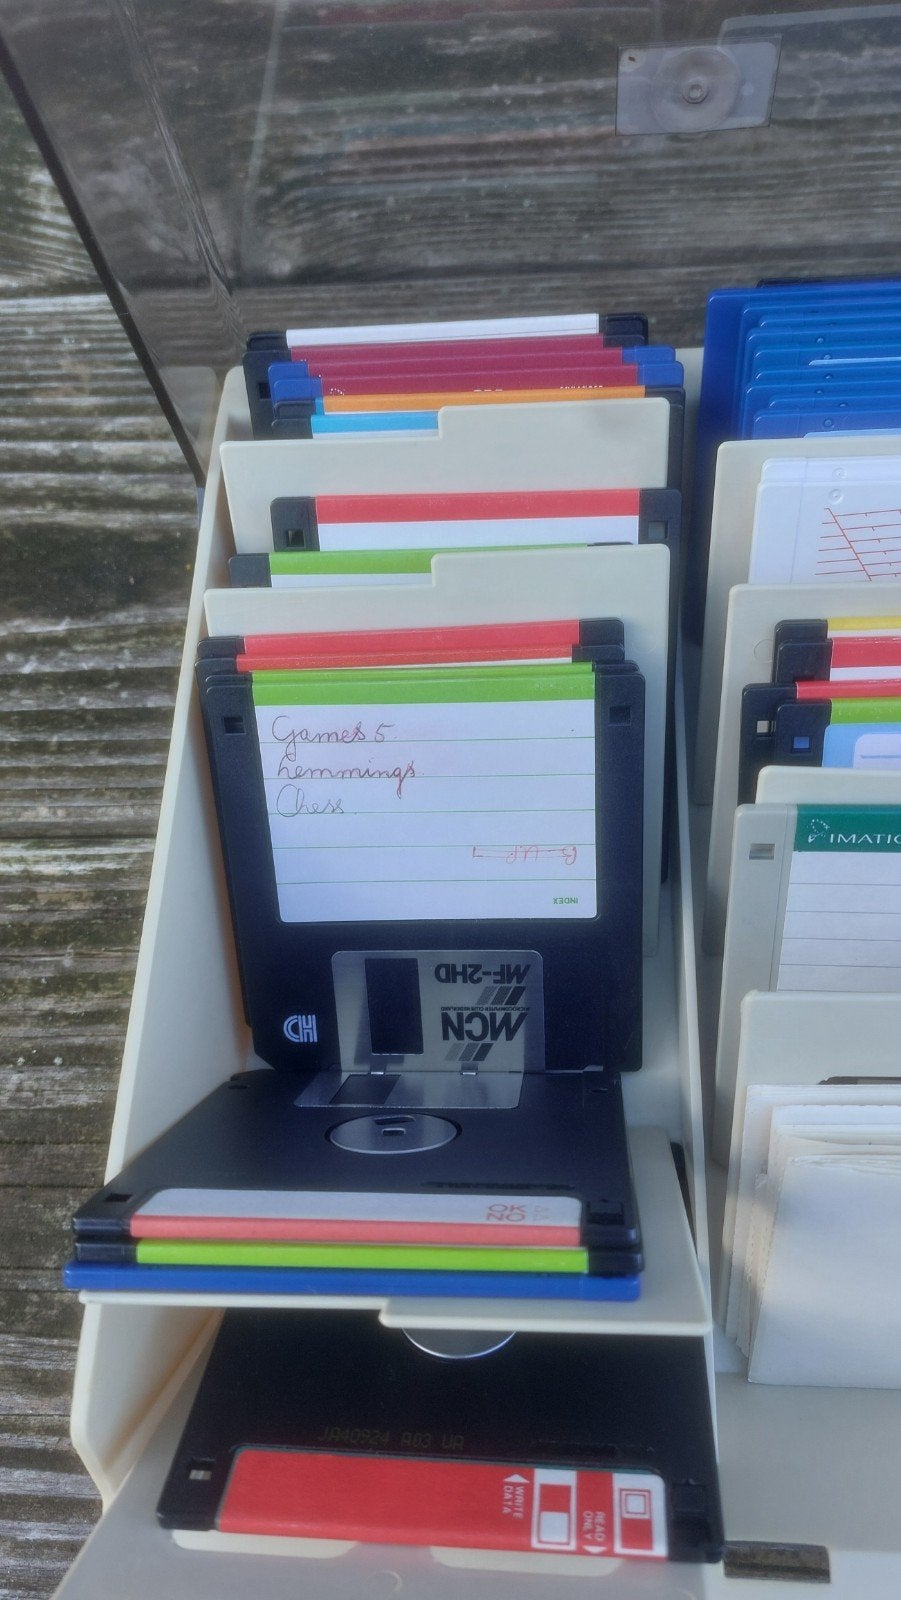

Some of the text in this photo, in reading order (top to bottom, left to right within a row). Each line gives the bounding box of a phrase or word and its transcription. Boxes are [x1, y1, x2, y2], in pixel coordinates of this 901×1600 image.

[272, 715, 366, 762] Games
[552, 897, 579, 905] INDEX
[434, 963, 532, 985] MF-2HD
[282, 1013, 318, 1043] HD
[440, 1012, 528, 1042] MCN
[486, 1212, 526, 1222] NO
[488, 1203, 527, 1213] OK
[502, 1485, 513, 1515] DATA
[513, 1486, 525, 1519] WRITE
[582, 1511, 594, 1540] ONLY
[594, 1511, 606, 1541] READ
